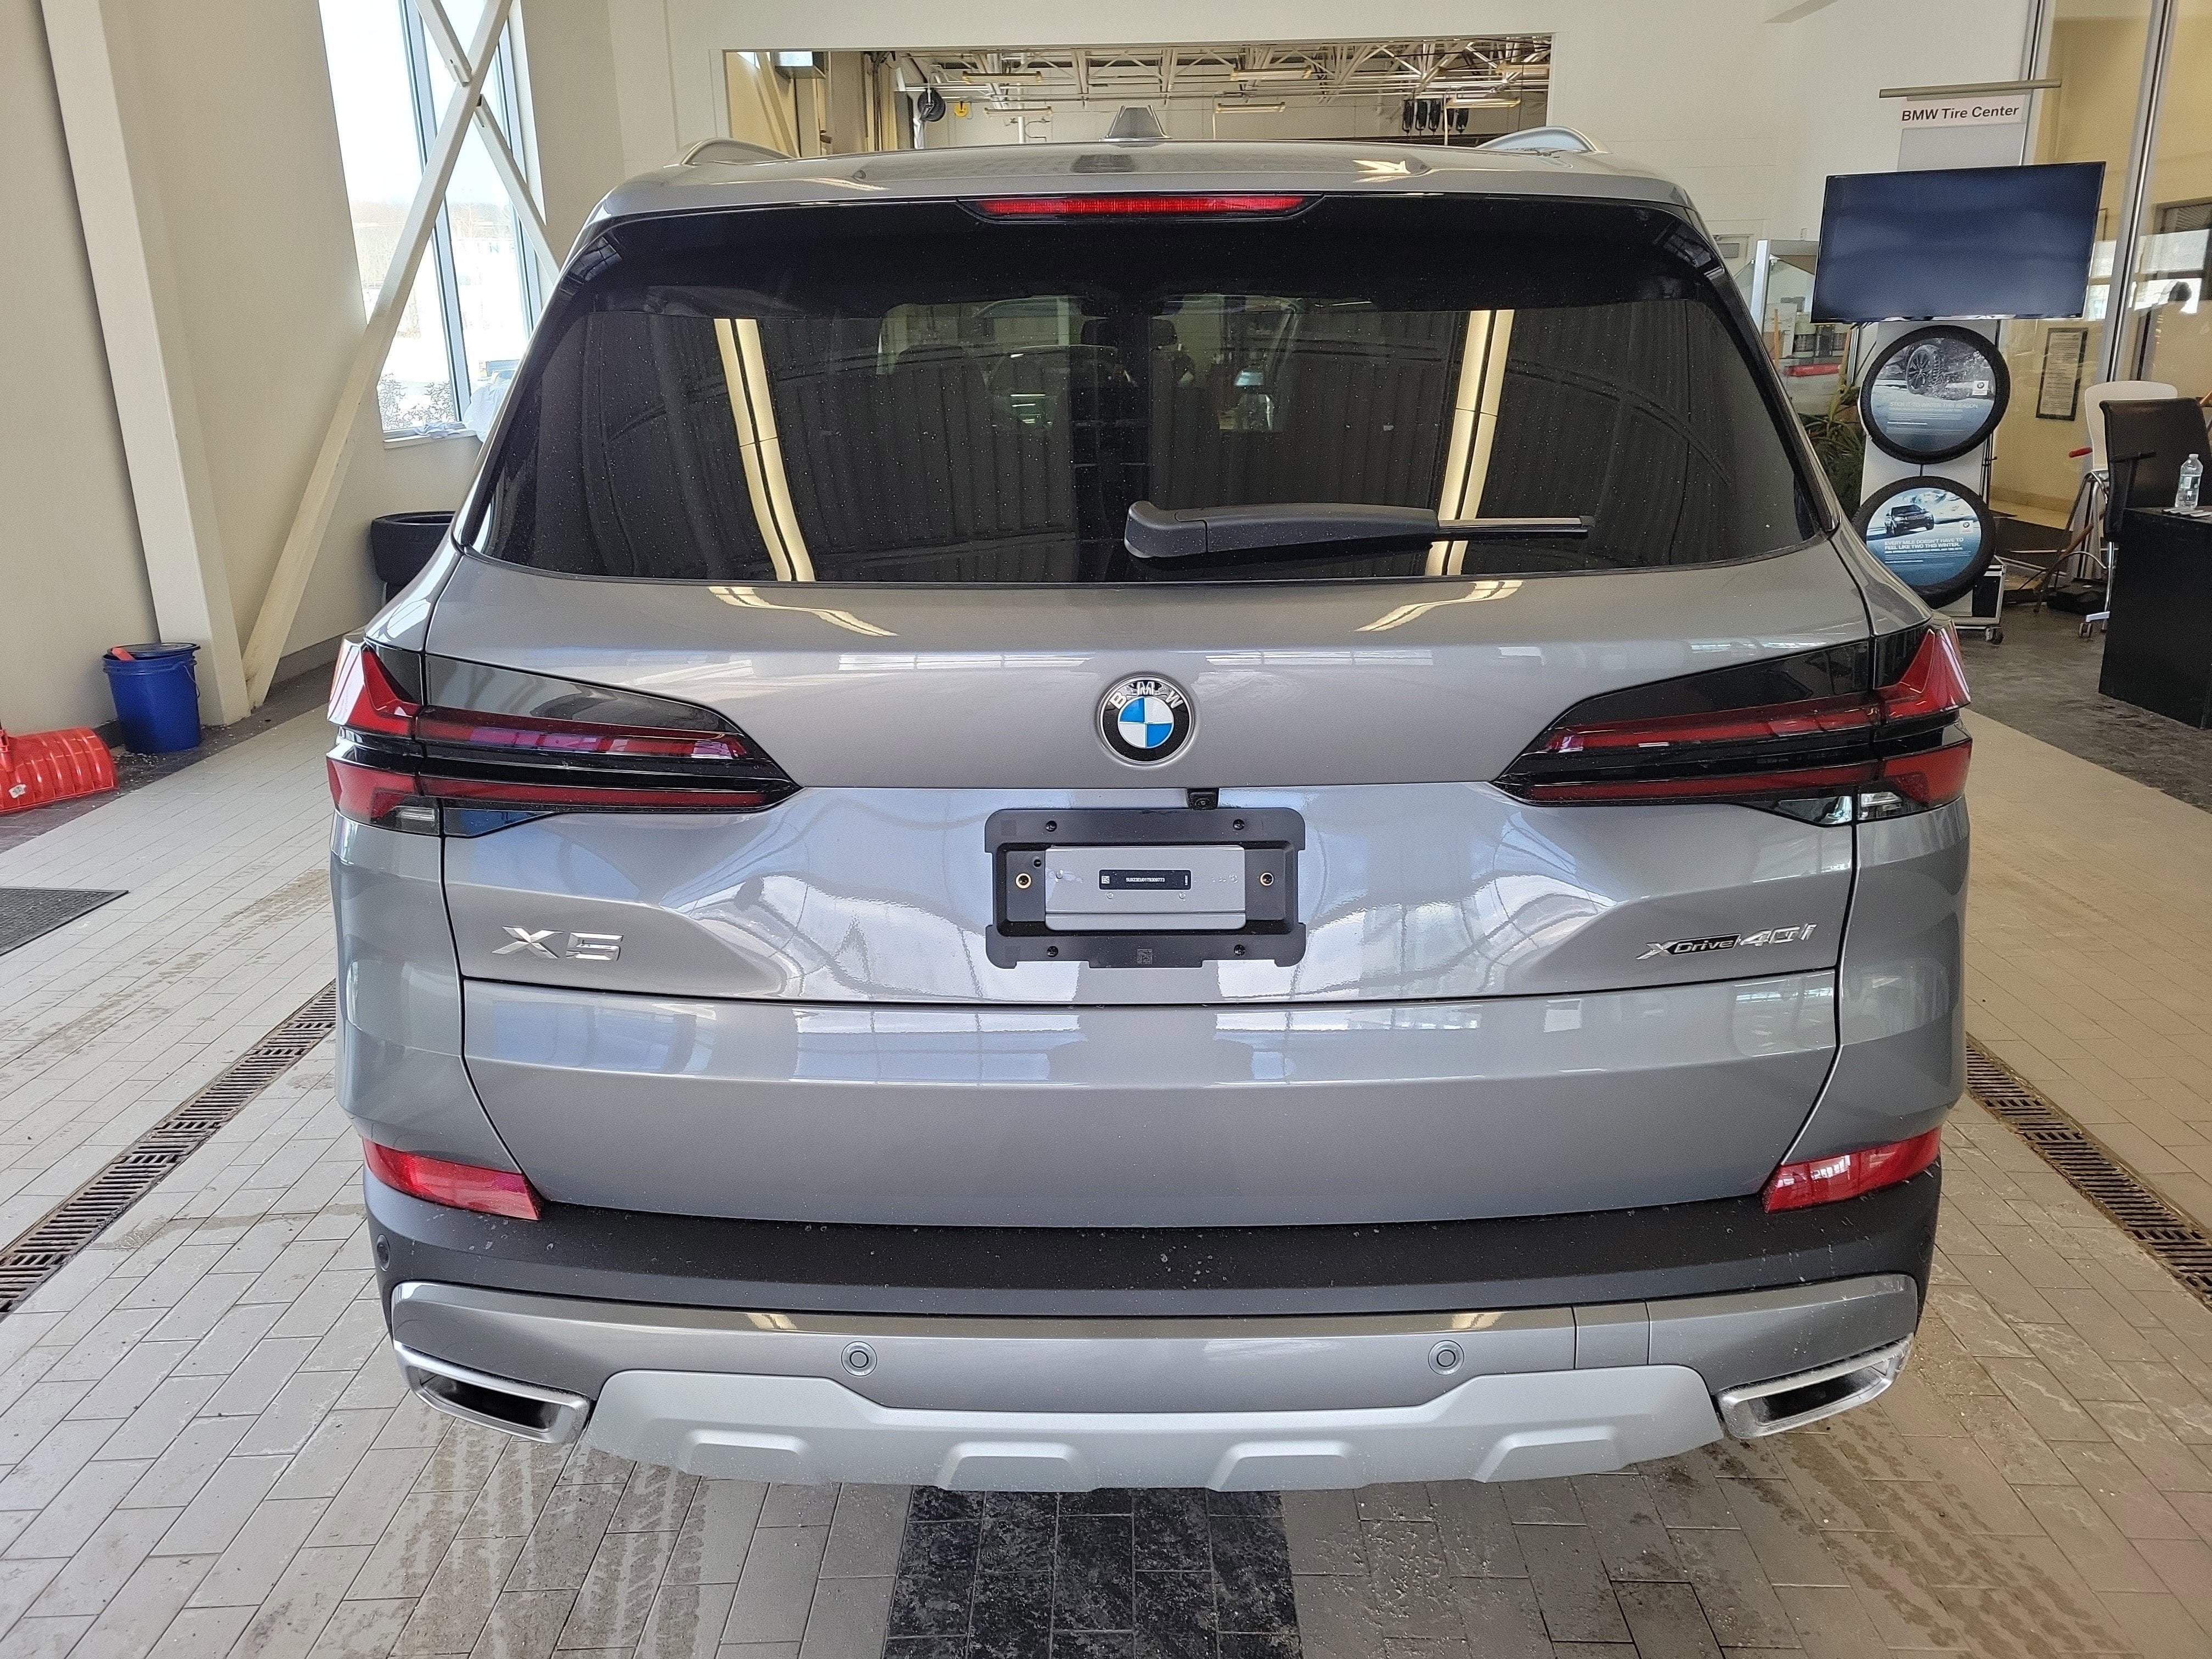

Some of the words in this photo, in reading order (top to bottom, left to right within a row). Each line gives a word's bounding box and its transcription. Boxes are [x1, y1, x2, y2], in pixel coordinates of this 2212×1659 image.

[1901, 109, 1939, 121] BMW
[1942, 108, 1968, 119] Tire
[1972, 105, 2019, 117] Center
[1109, 681, 1183, 709] BMW
[492, 926, 624, 961] X5
